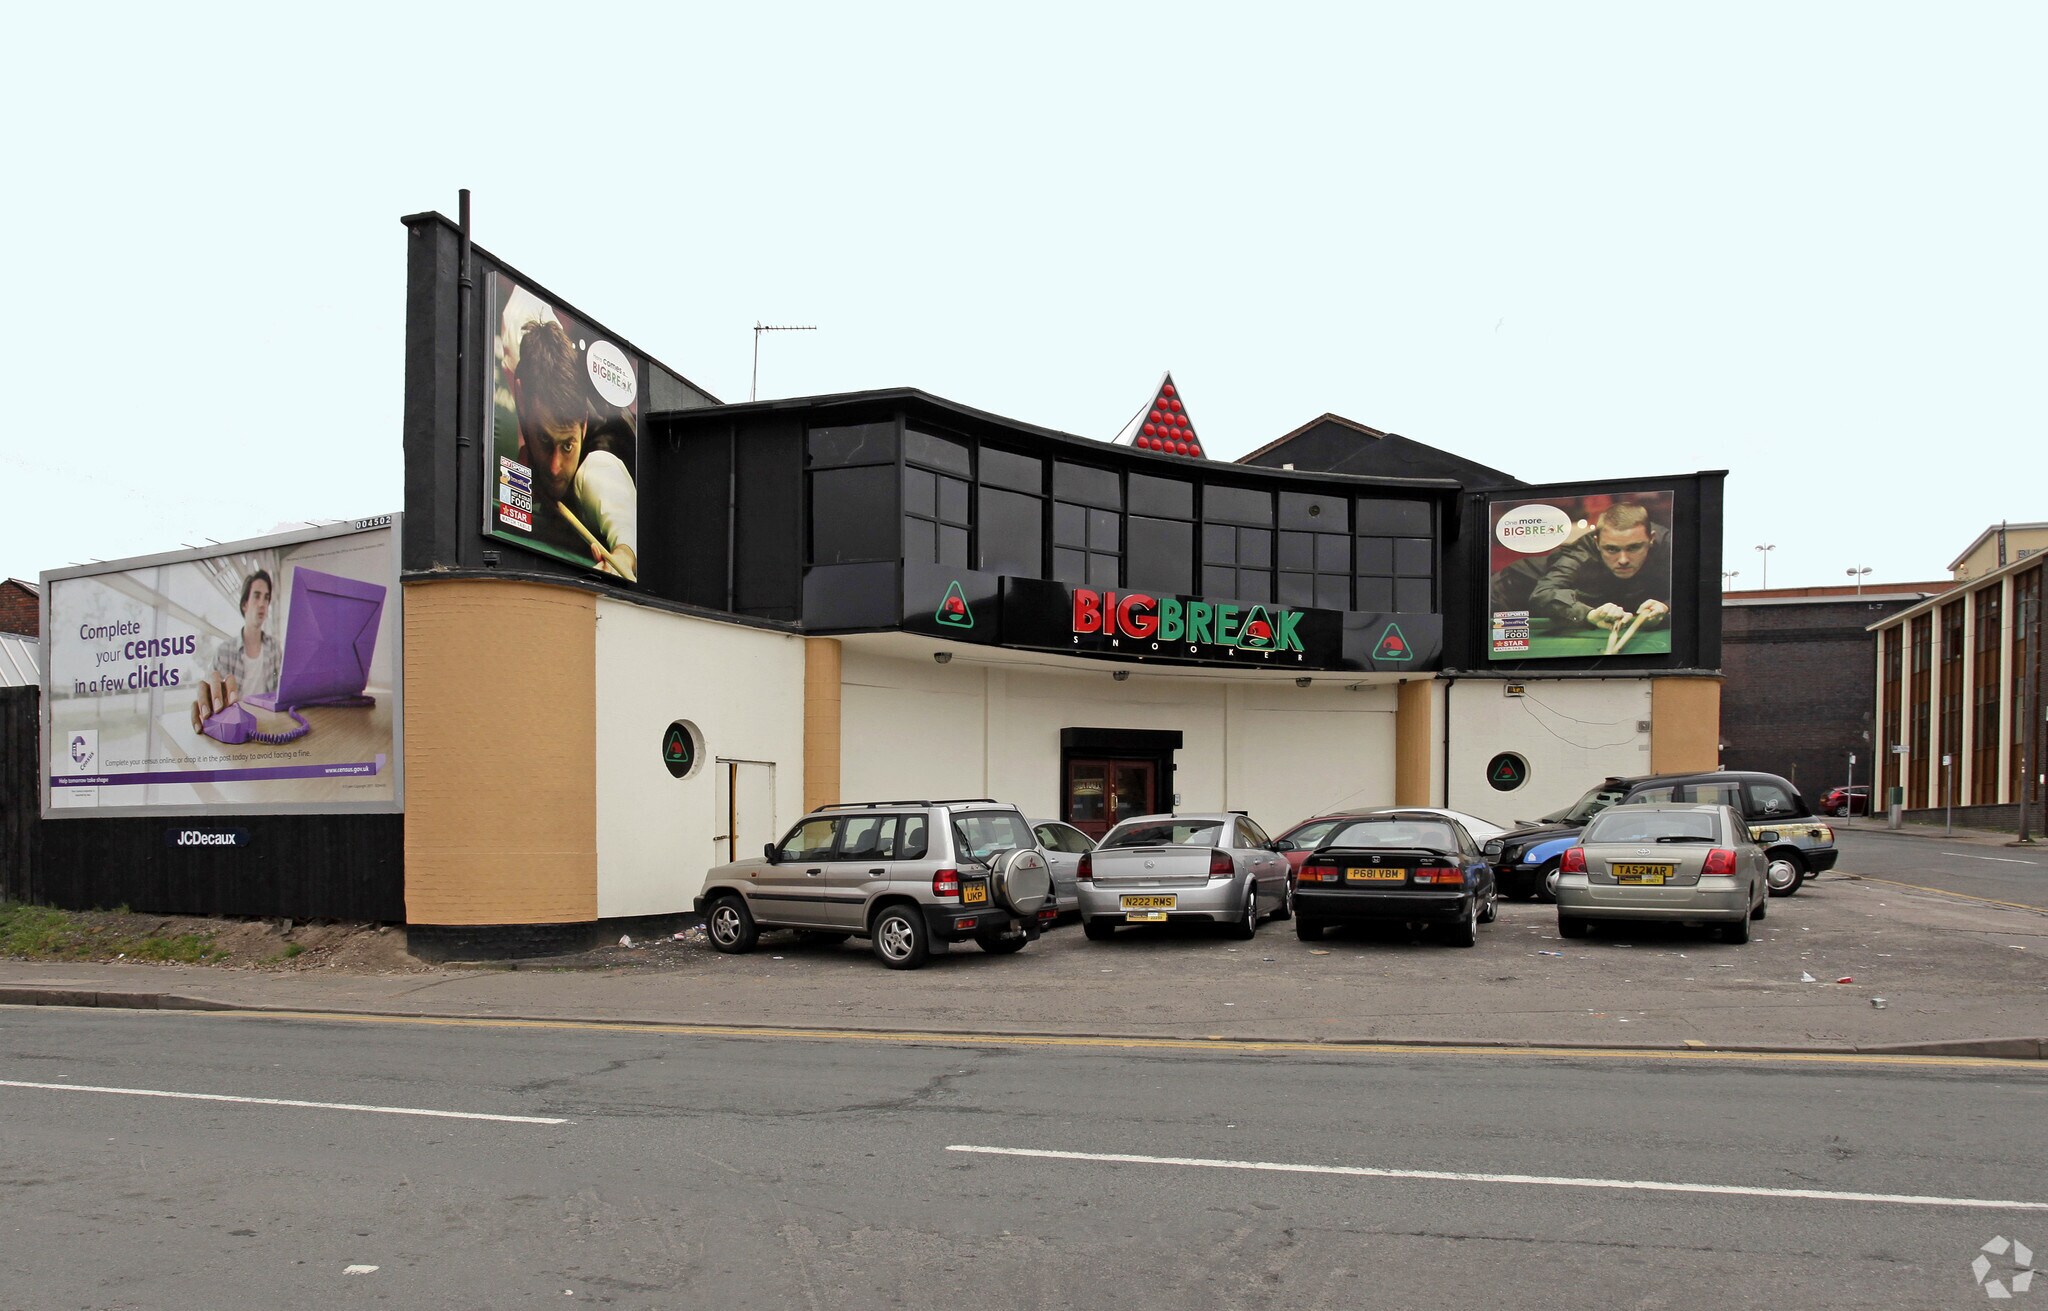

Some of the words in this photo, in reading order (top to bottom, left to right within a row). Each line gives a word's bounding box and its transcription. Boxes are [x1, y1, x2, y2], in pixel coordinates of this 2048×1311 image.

[511, 496, 531, 510] FOOD
[356, 516, 391, 529] 004502
[509, 508, 527, 523] STAR
[80, 620, 141, 642] Complete
[96, 650, 121, 667] your
[124, 634, 196, 660] census
[1073, 635, 1303, 661] SNOOKER
[75, 678, 86, 693] in
[89, 680, 97, 692] a
[100, 675, 124, 691] few
[128, 663, 180, 689] clicks
[80, 751, 94, 771] Census
[105, 759, 129, 767] Complete
[129, 759, 141, 767] your
[219, 755, 232, 763] post
[232, 753, 249, 761] today
[273, 751, 291, 759] facing
[325, 766, 369, 774] www.census.gov.uk
[177, 831, 236, 845] JCDecaux
[1352, 869, 1377, 878] P681
[1378, 869, 1399, 878] VBM
[1618, 865, 1667, 875] TA52WAR
[967, 892, 982, 901] UKP
[1125, 897, 1151, 906] N222
[1152, 897, 1172, 906] RMS
